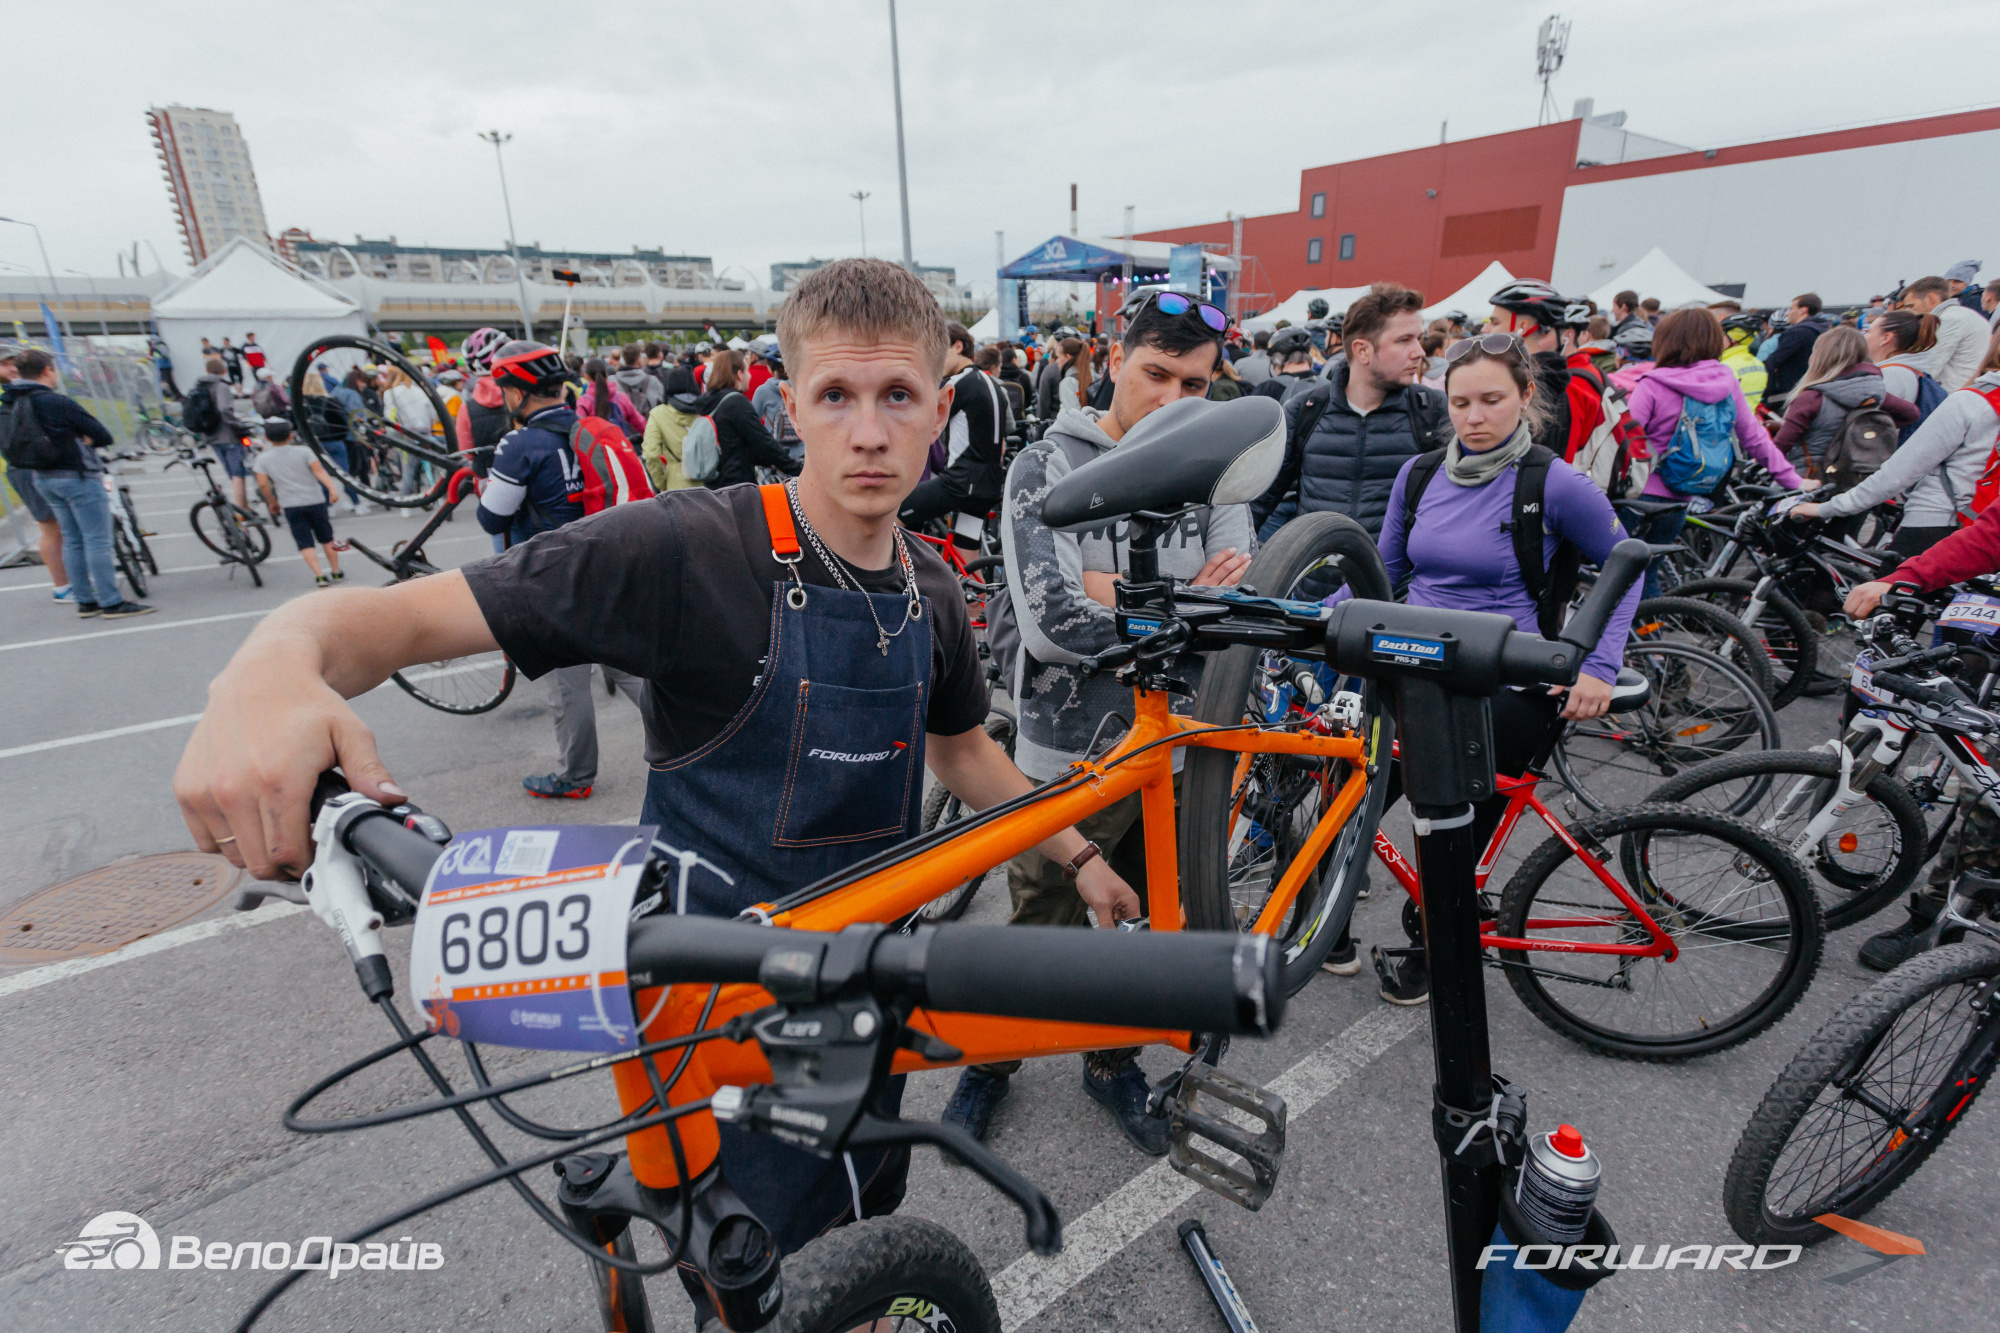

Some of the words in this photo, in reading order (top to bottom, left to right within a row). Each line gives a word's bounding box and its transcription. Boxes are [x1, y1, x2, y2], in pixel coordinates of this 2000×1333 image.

[1949, 606, 1997, 620] 3744
[1394, 655, 1420, 665] PRS-25
[808, 748, 890, 762] FORWARD
[441, 895, 592, 975] 6803
